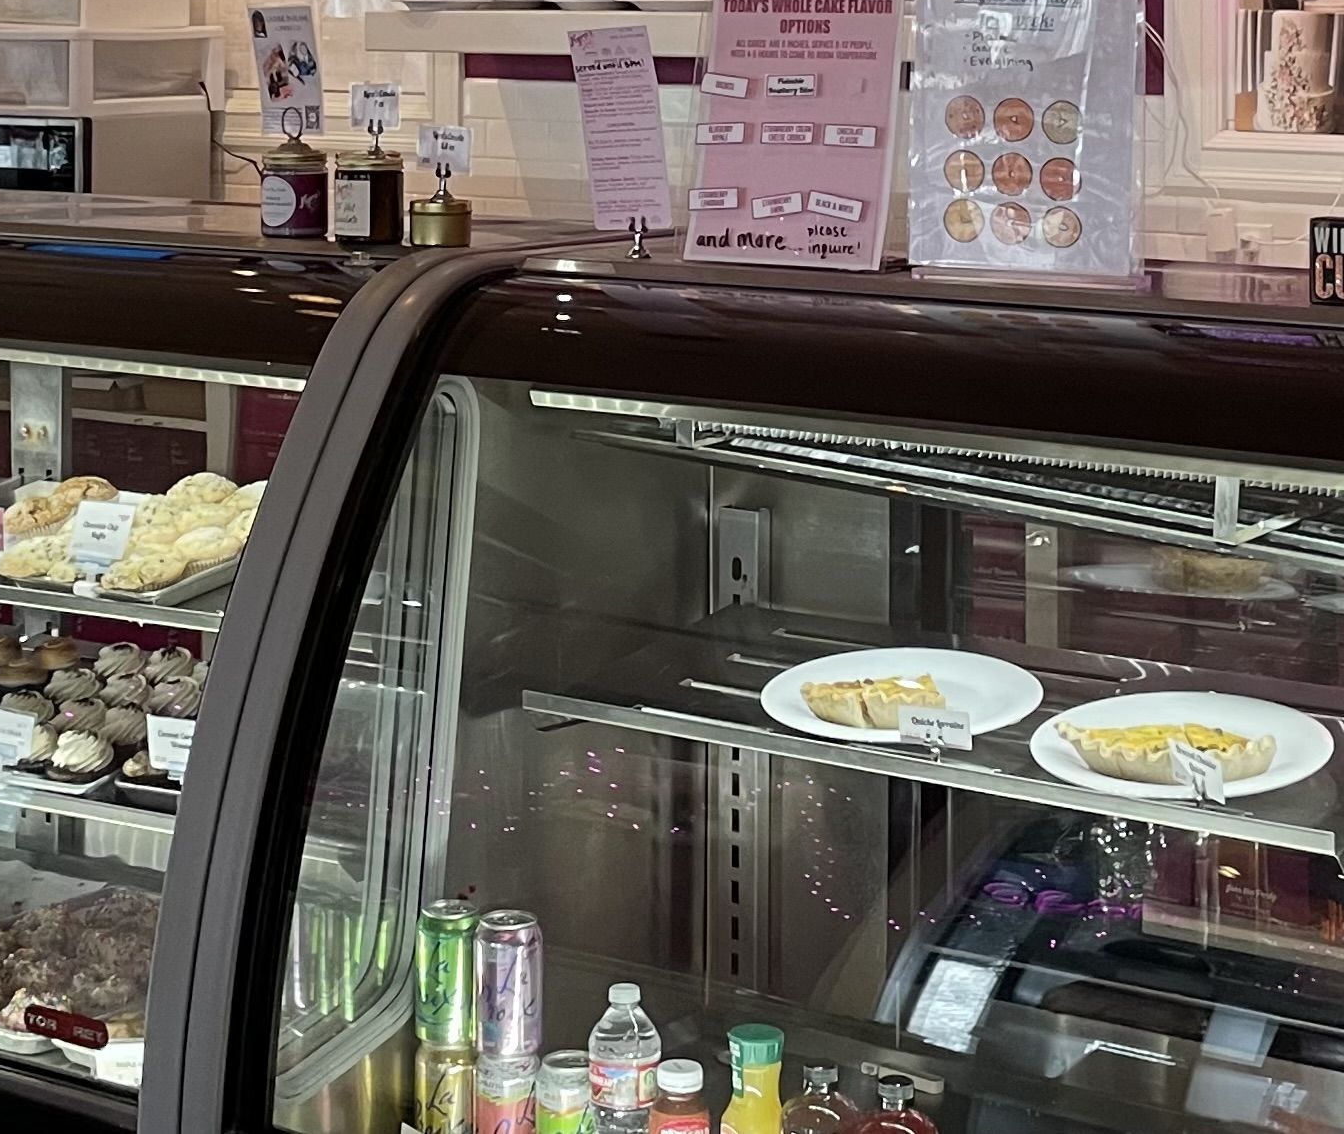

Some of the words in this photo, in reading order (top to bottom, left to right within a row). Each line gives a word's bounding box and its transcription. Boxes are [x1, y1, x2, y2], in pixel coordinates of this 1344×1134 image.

[814, 0, 845, 14] CAKE
[847, 0, 893, 14] FLAVOR
[779, 19, 831, 34] OPTIONS
[696, 227, 730, 249] and
[807, 224, 848, 238] please
